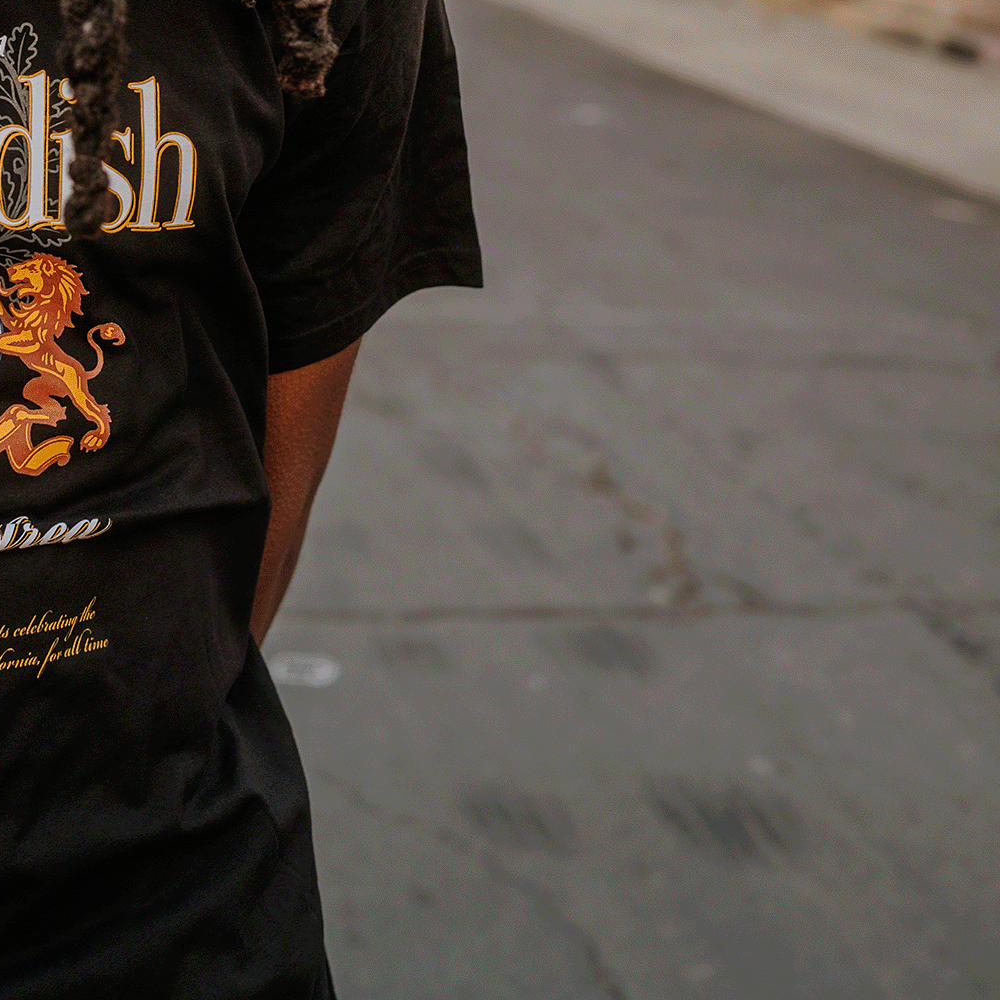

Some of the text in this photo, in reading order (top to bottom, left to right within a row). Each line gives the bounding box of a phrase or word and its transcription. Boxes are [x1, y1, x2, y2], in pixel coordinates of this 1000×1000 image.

[13, 609, 78, 642] celebrating
[79, 596, 97, 623] the
[37, 636, 62, 679] for
[64, 627, 92, 659] all
[84, 636, 110, 653] time
